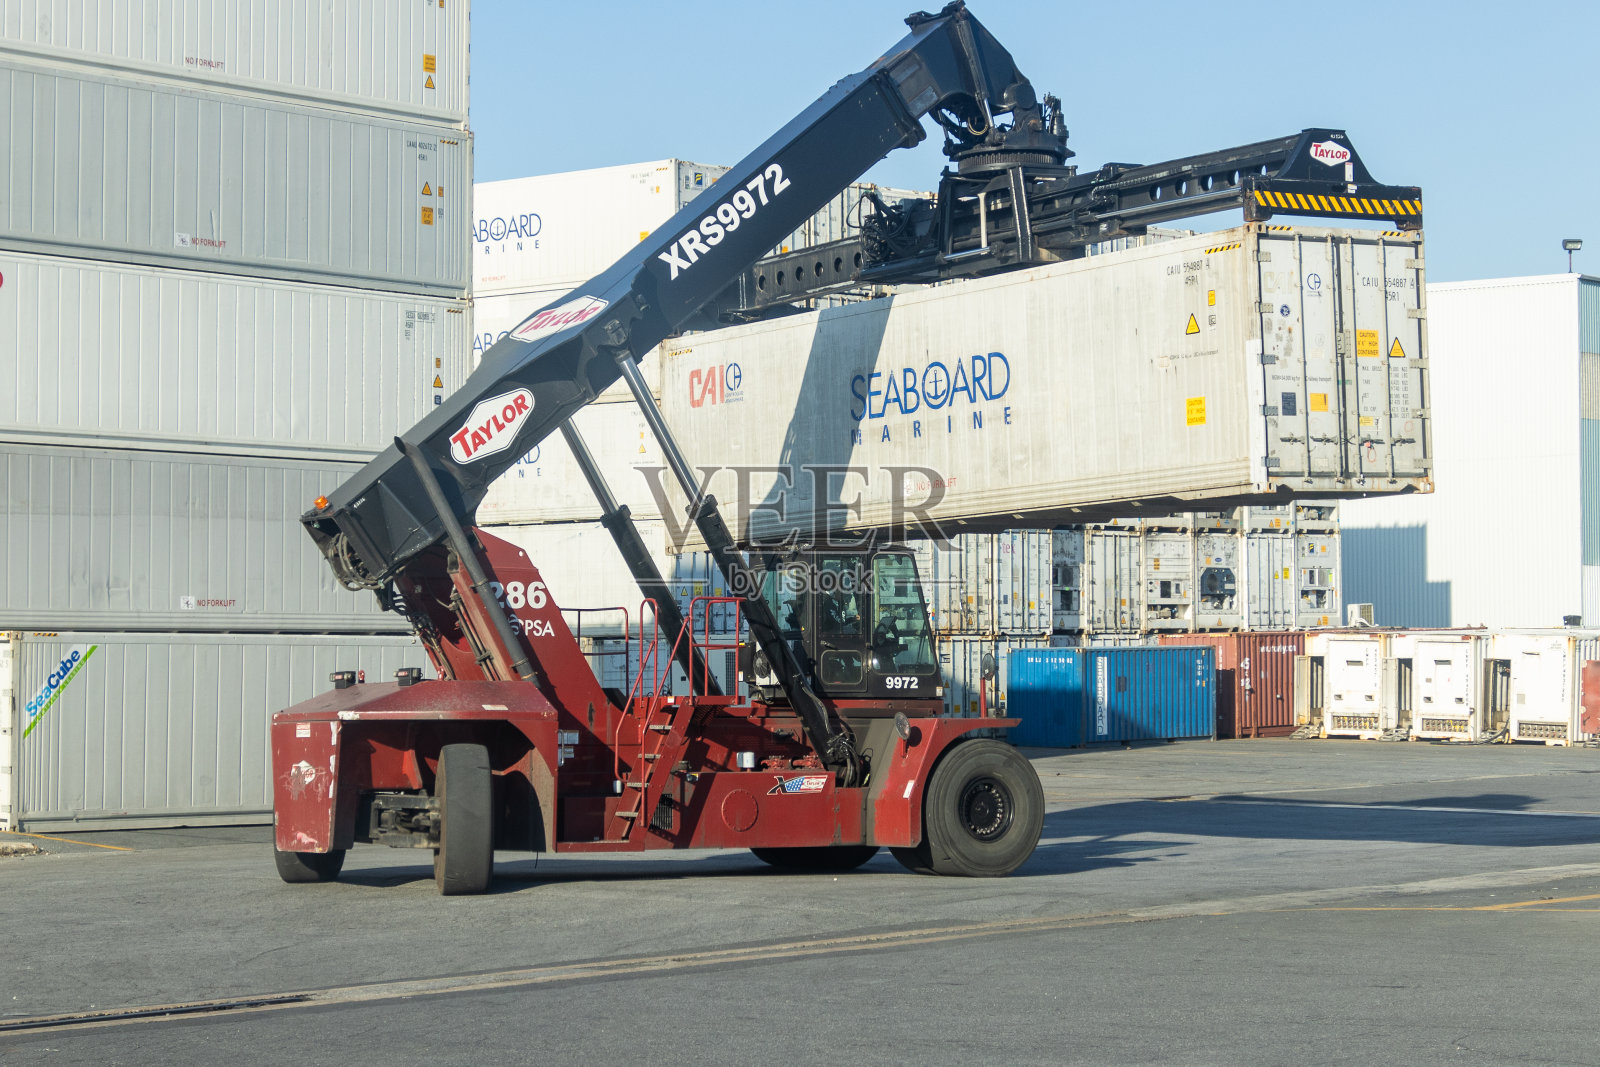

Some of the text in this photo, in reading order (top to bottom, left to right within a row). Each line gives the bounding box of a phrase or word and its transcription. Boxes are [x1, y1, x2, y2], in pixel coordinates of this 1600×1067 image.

[185, 57, 224, 69] NO FORKLIFT
[1313, 144, 1348, 160] TAYLOR
[657, 163, 792, 280] XRS9972
[191, 237, 227, 248] NO FORKLIFT
[1167, 265, 1181, 276] CAIU
[1183, 260, 1203, 273] 554887
[1362, 277, 1379, 287] CAIU
[518, 306, 600, 334] TAYLOR
[689, 365, 724, 408] CAI
[851, 352, 1011, 421] SEABOARD
[451, 394, 530, 458] TAYLOR
[851, 406, 1012, 446] MARINE
[917, 482, 925, 491] NO
[207, 599, 236, 607] FORKLIFT
[488, 581, 547, 609] 286
[25, 650, 80, 717] SeaCube
[885, 677, 919, 689] 9972
